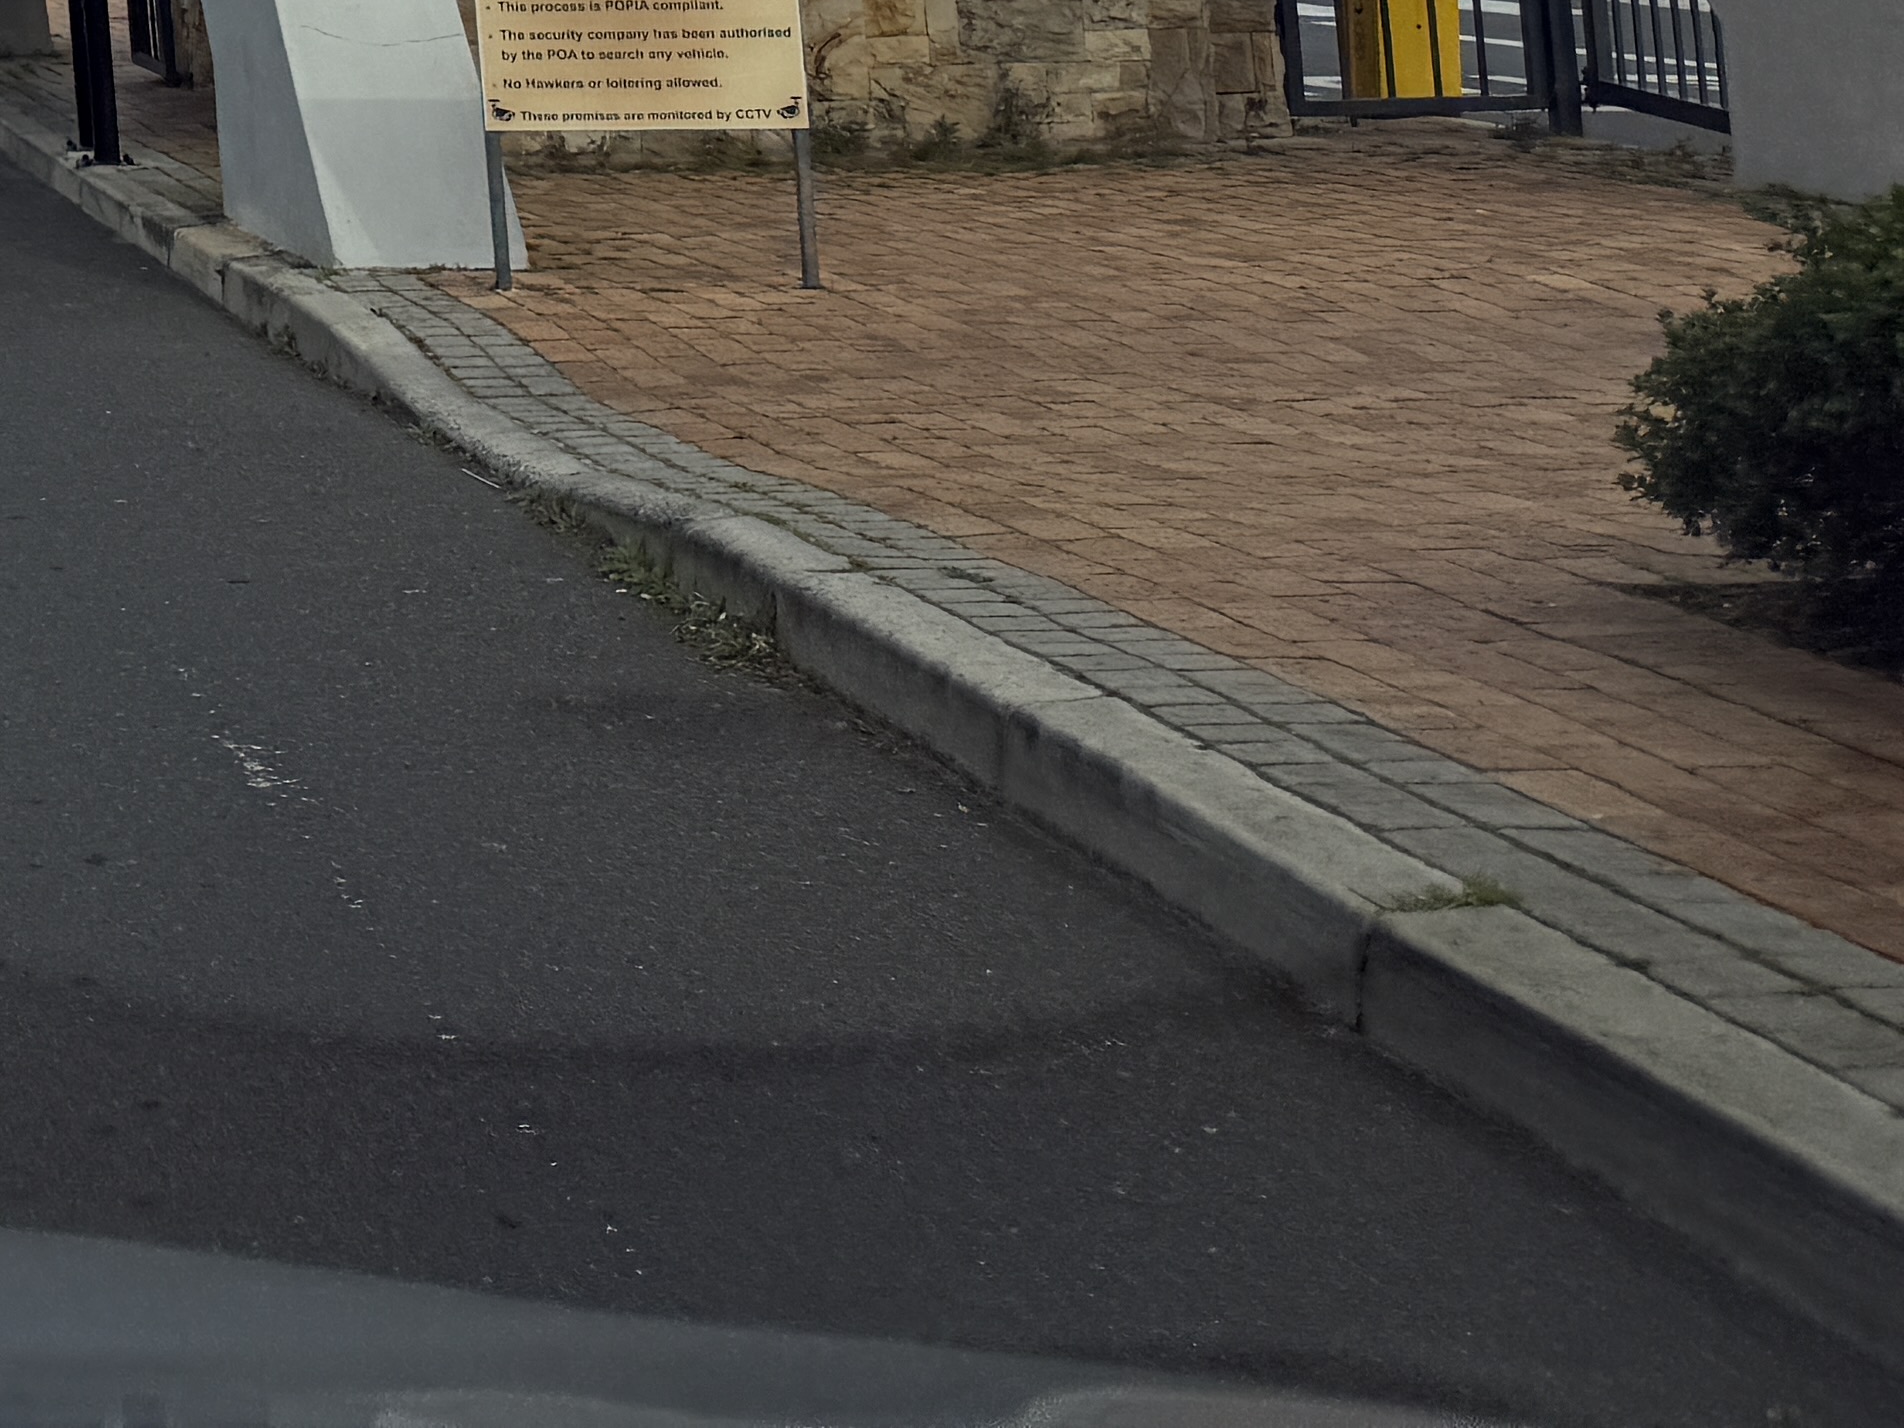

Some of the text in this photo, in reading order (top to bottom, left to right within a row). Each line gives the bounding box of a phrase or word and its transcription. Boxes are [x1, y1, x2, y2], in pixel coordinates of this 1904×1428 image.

[497, 0, 724, 14] This process is POPIA compliant.
[499, 26, 791, 42] The security company has been authorised
[502, 48, 728, 63] by the POA to search any vehicle.
[503, 76, 723, 90] No Hawkers or loitering allowed.
[520, 108, 772, 122] These premises are monitored by CCTV
